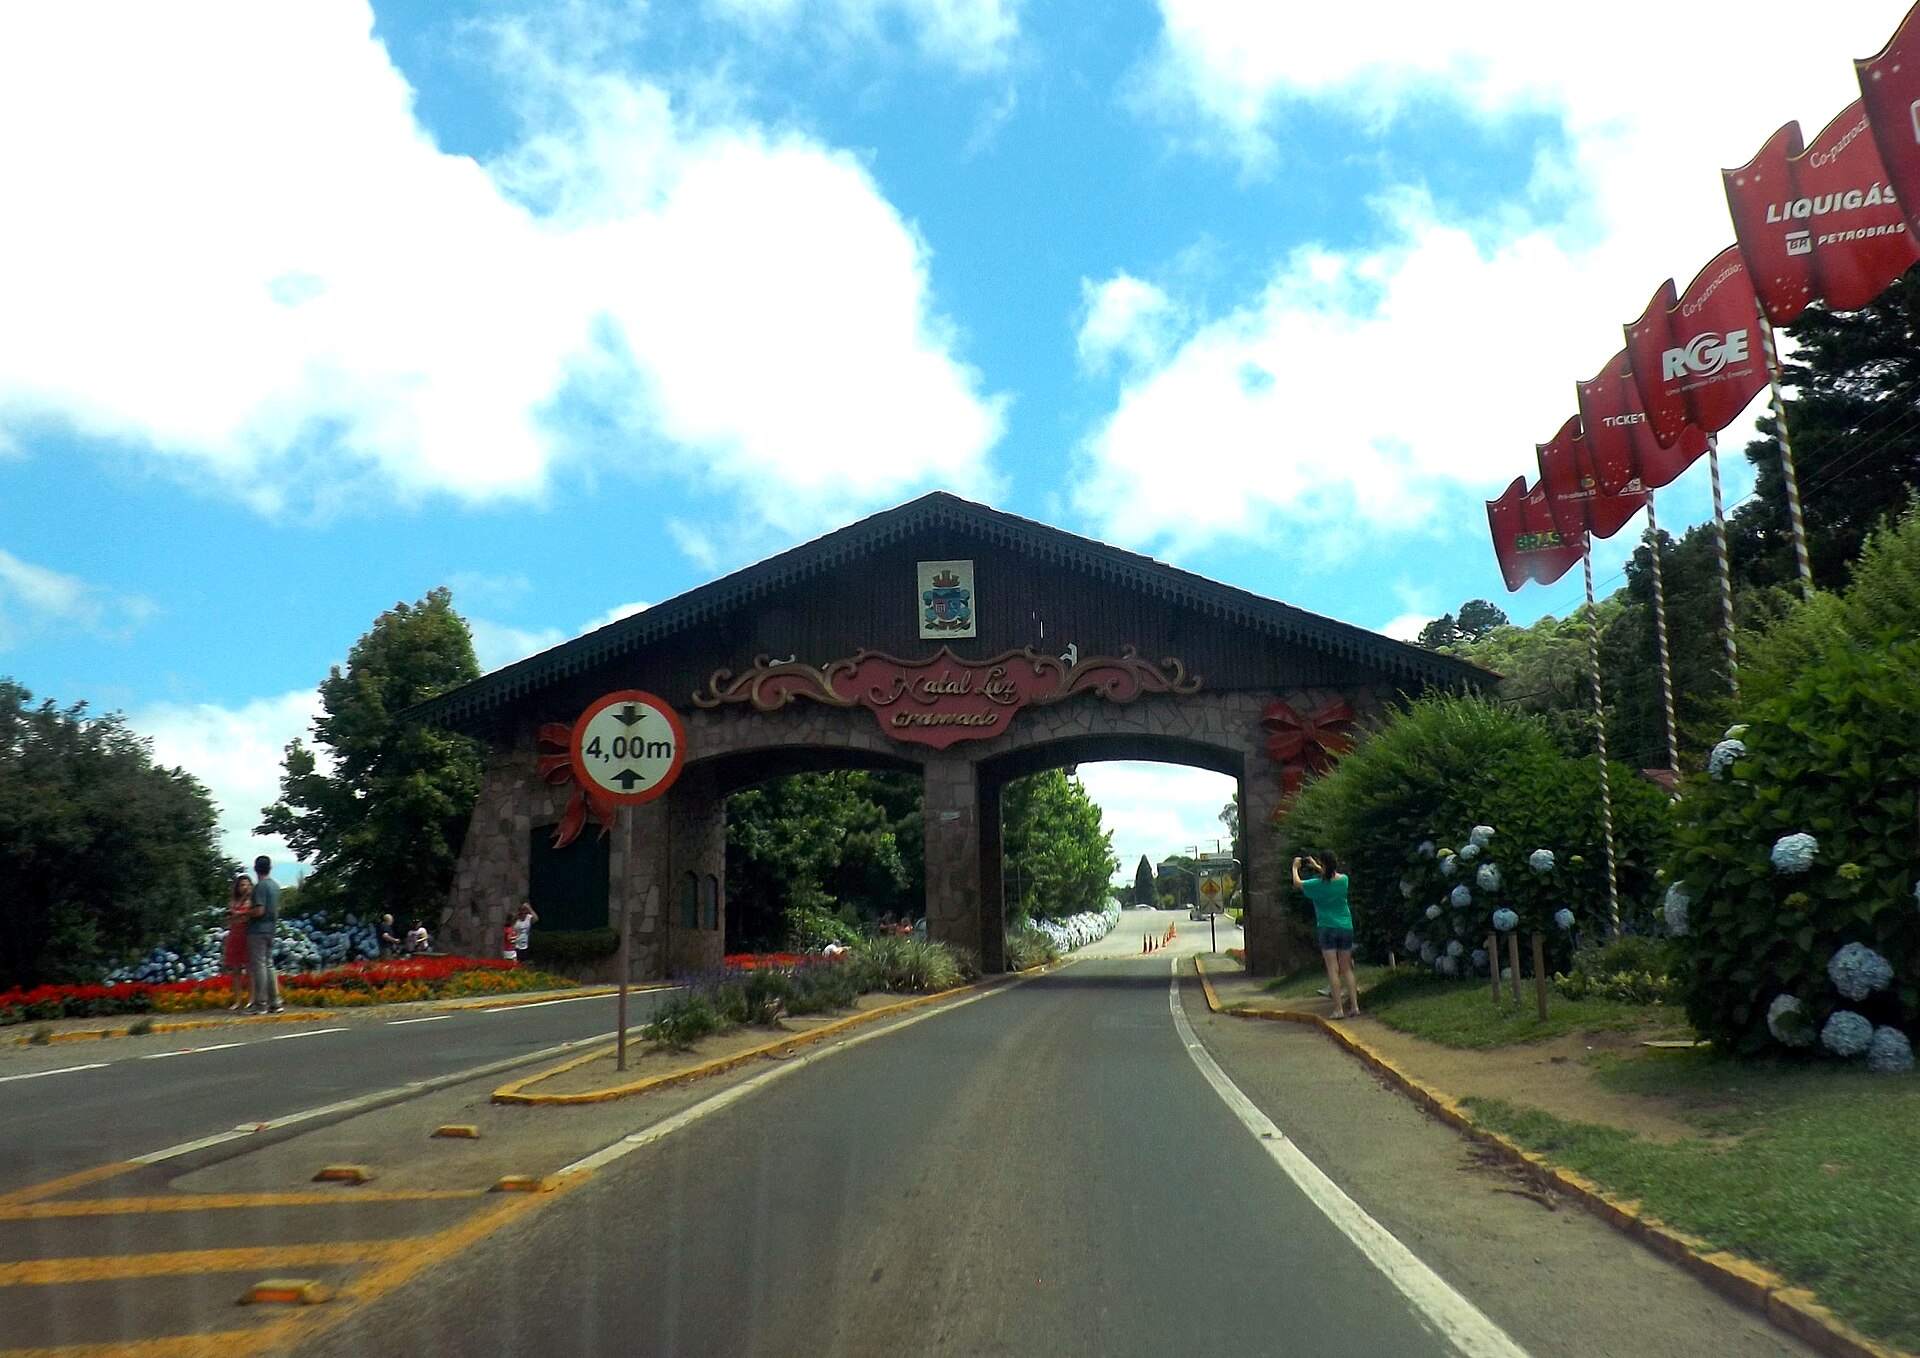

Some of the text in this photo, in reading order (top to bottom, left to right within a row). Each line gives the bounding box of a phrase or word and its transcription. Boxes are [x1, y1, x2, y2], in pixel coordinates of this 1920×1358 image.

[1766, 182, 1898, 224] LIQUIGÁS
[1817, 223, 1906, 246] PETROBRAS
[1662, 329, 1749, 382] RGE
[868, 664, 1021, 706] Natal Luz
[890, 708, 999, 729] Gramado
[586, 735, 672, 763] 4,00m
